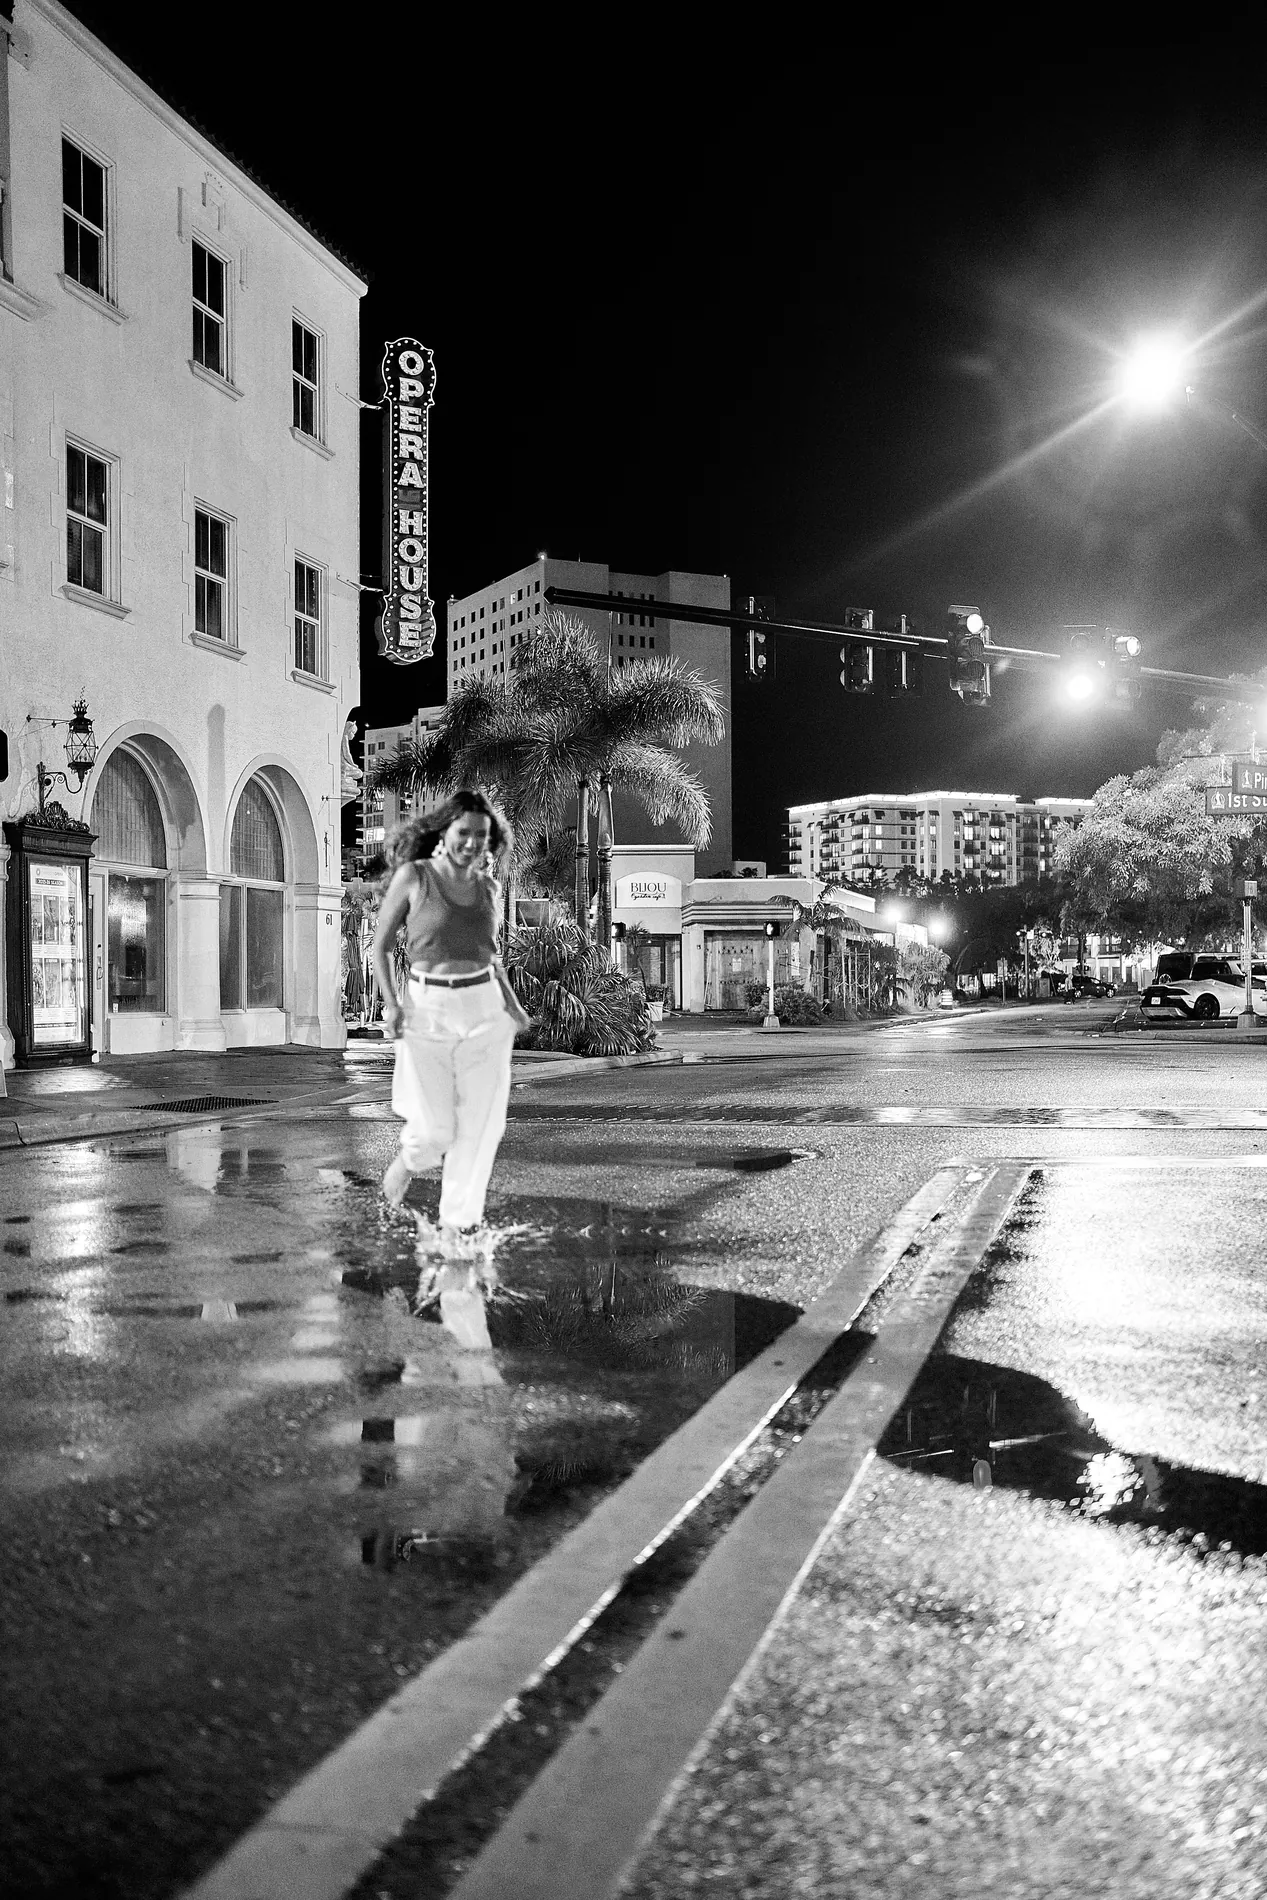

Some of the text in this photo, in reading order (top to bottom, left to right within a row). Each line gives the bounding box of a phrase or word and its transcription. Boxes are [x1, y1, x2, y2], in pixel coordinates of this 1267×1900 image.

[397, 350, 425, 648] OPERA HOUSE
[1227, 791, 1248, 808] 1st
[631, 882, 667, 893] BIJOU
[325, 913, 333, 925] 61
